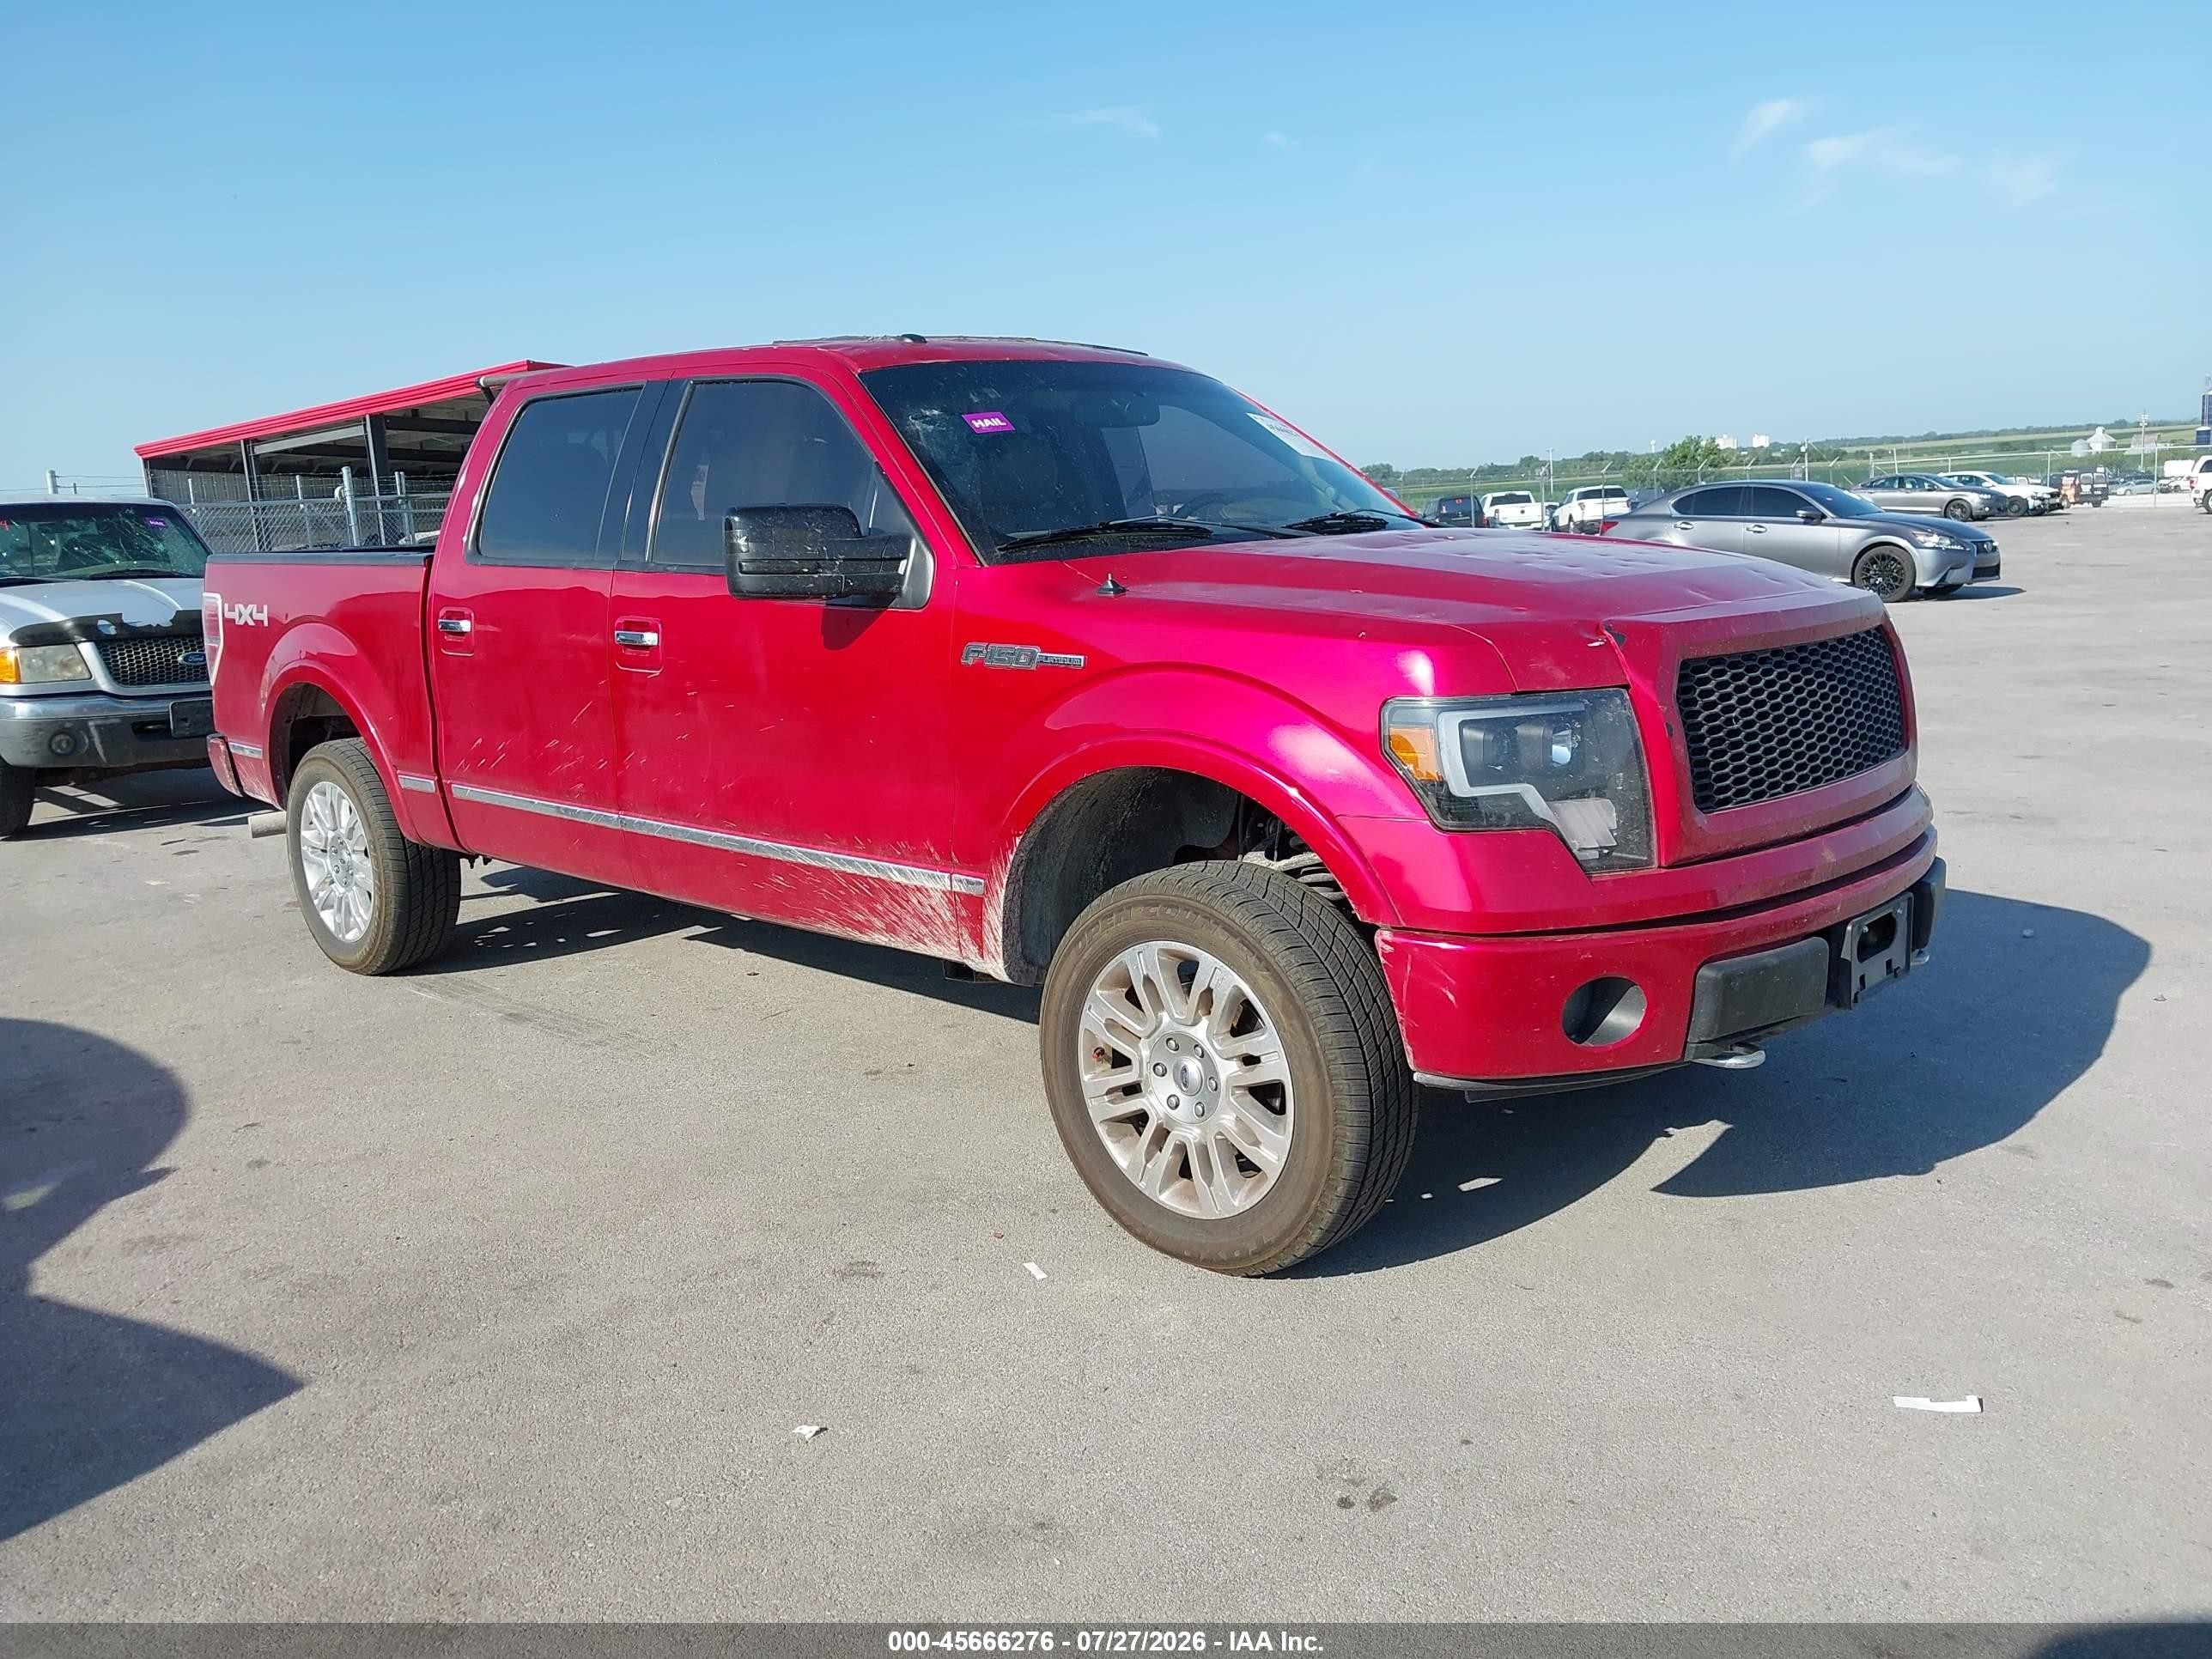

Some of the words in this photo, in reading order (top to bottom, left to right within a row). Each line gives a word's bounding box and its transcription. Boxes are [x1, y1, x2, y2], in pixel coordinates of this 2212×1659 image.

[971, 417, 1006, 428] HAIL
[961, 641, 1041, 670] F-150
[1037, 655, 1081, 666] PLATINUM
